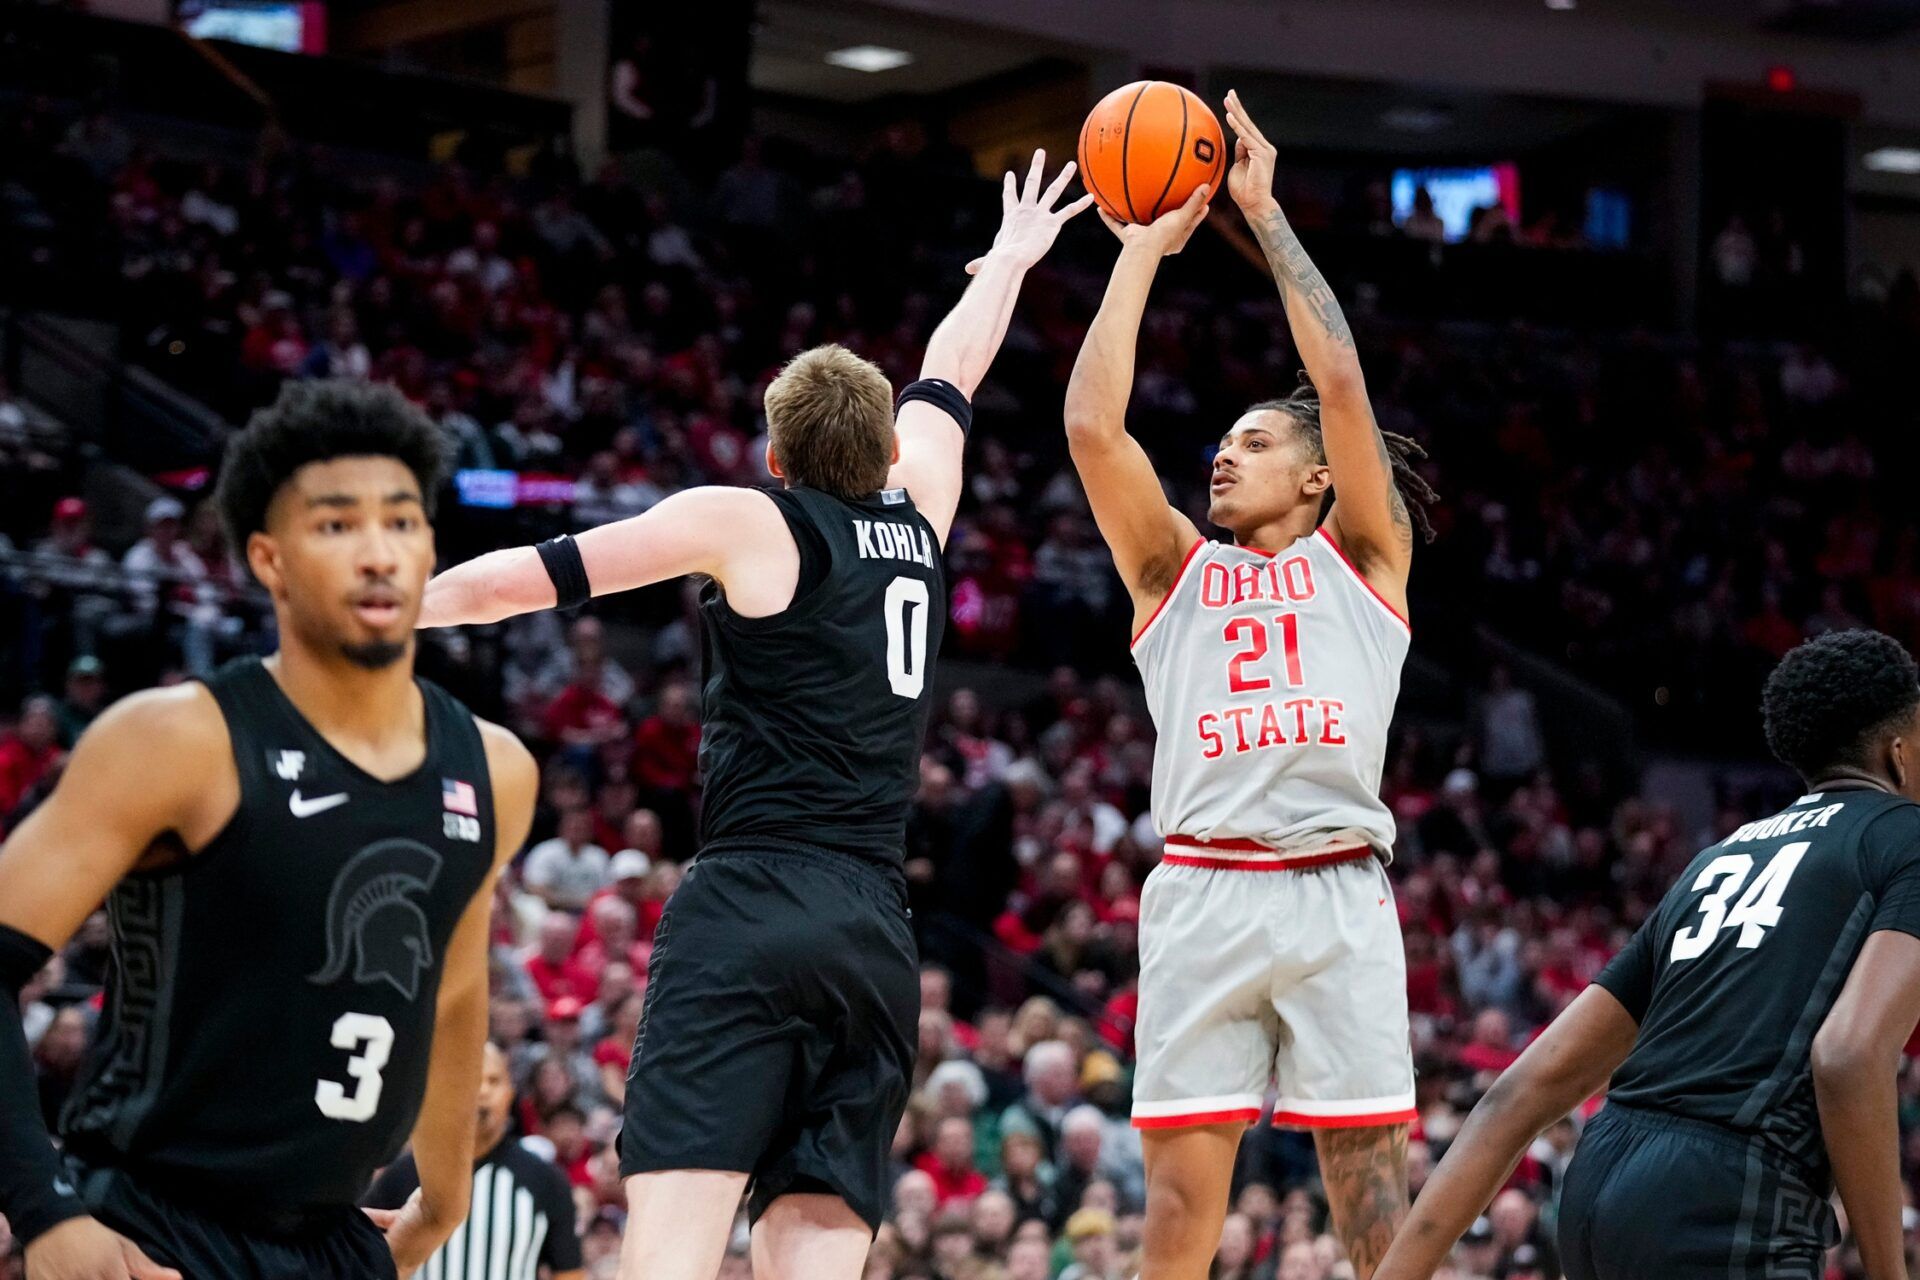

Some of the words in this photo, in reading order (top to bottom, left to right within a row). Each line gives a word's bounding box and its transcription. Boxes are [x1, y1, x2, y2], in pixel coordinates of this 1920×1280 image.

[1199, 555, 1316, 610] OHIO
[884, 576, 929, 699] 0
[1222, 612, 1304, 694] 21
[1197, 698, 1347, 760] STATE
[1670, 841, 1812, 964] 34
[314, 1011, 395, 1122] 3
